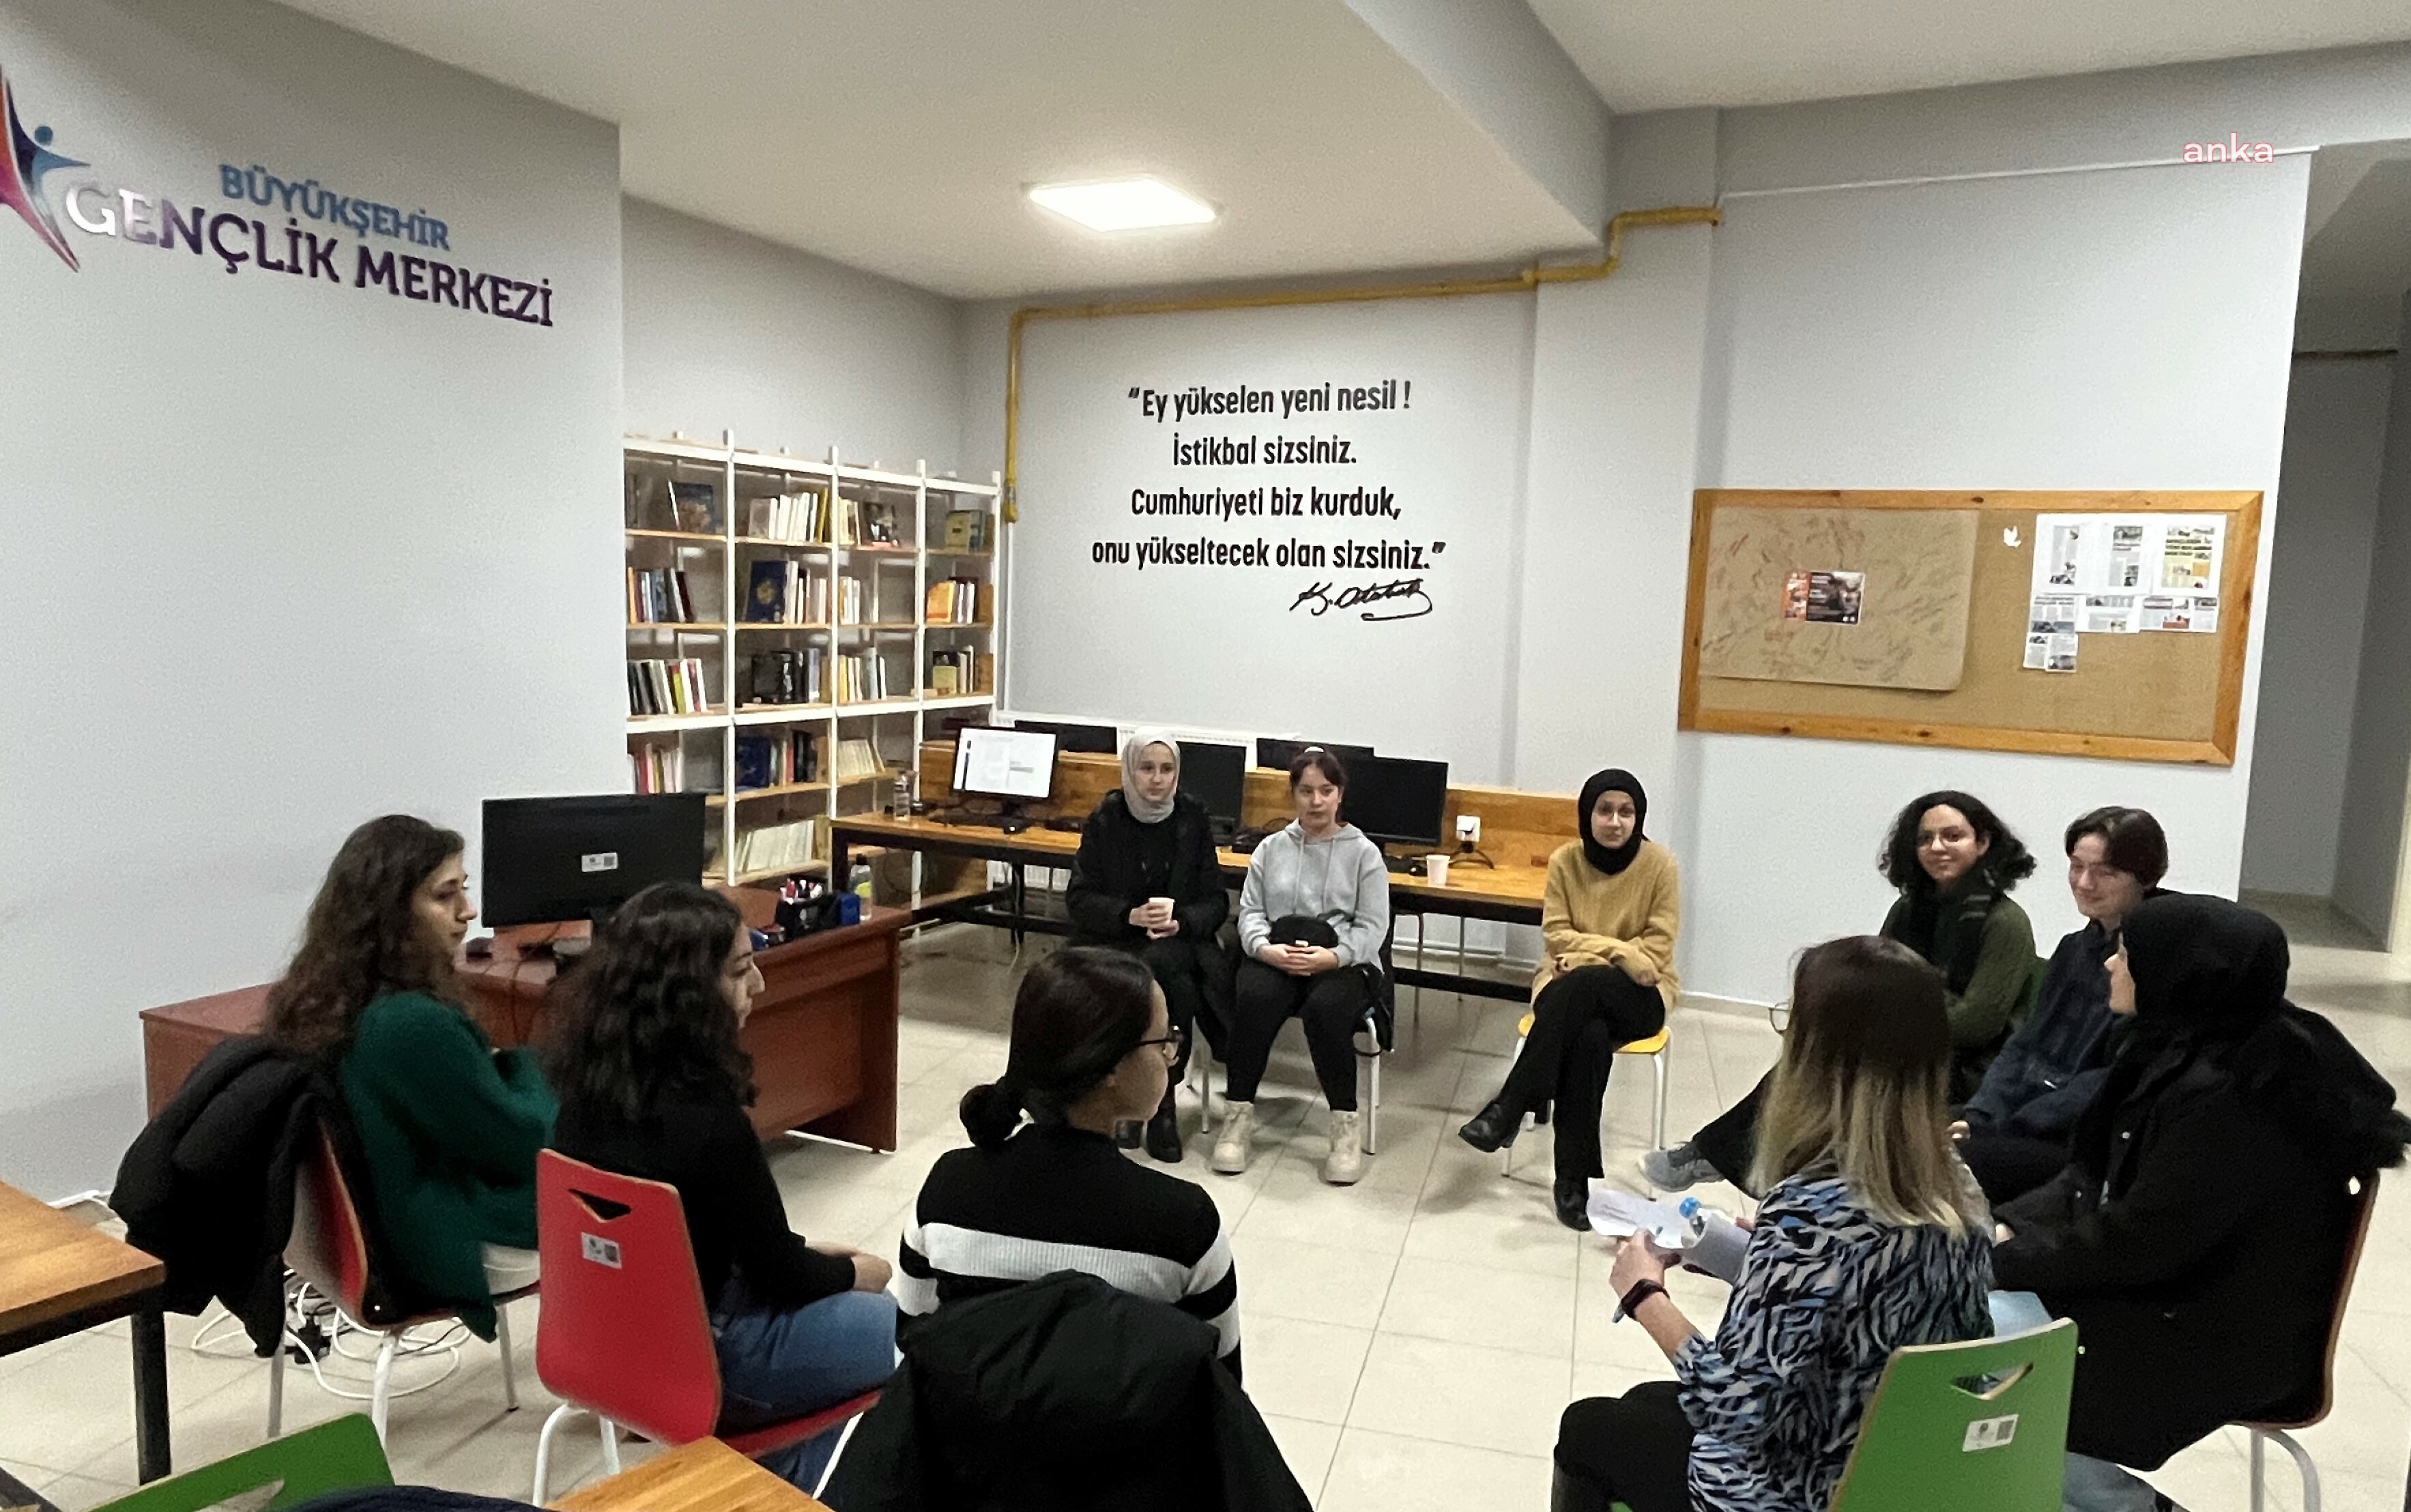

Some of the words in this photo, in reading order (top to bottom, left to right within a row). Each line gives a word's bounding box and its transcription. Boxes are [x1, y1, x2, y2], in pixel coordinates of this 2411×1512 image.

[218, 162, 451, 252] BÜYÜKŞEHİR
[65, 179, 341, 283] GENÇLİK
[354, 244, 554, 328] MERKEZİ
[1174, 383, 1275, 422] yükselen
[1280, 381, 1331, 420] yeni
[1338, 379, 1397, 411] nesil
[1173, 432, 1257, 467] İstikbal
[1263, 434, 1357, 465] sizsiniz.
[1131, 486, 1265, 522] Cumhuriyeti
[1271, 486, 1304, 517] biz
[1310, 485, 1402, 521] kurduk,
[1092, 542, 1131, 565] onu
[1136, 536, 1271, 571] yükseltecek
[1276, 537, 1326, 568] olan
